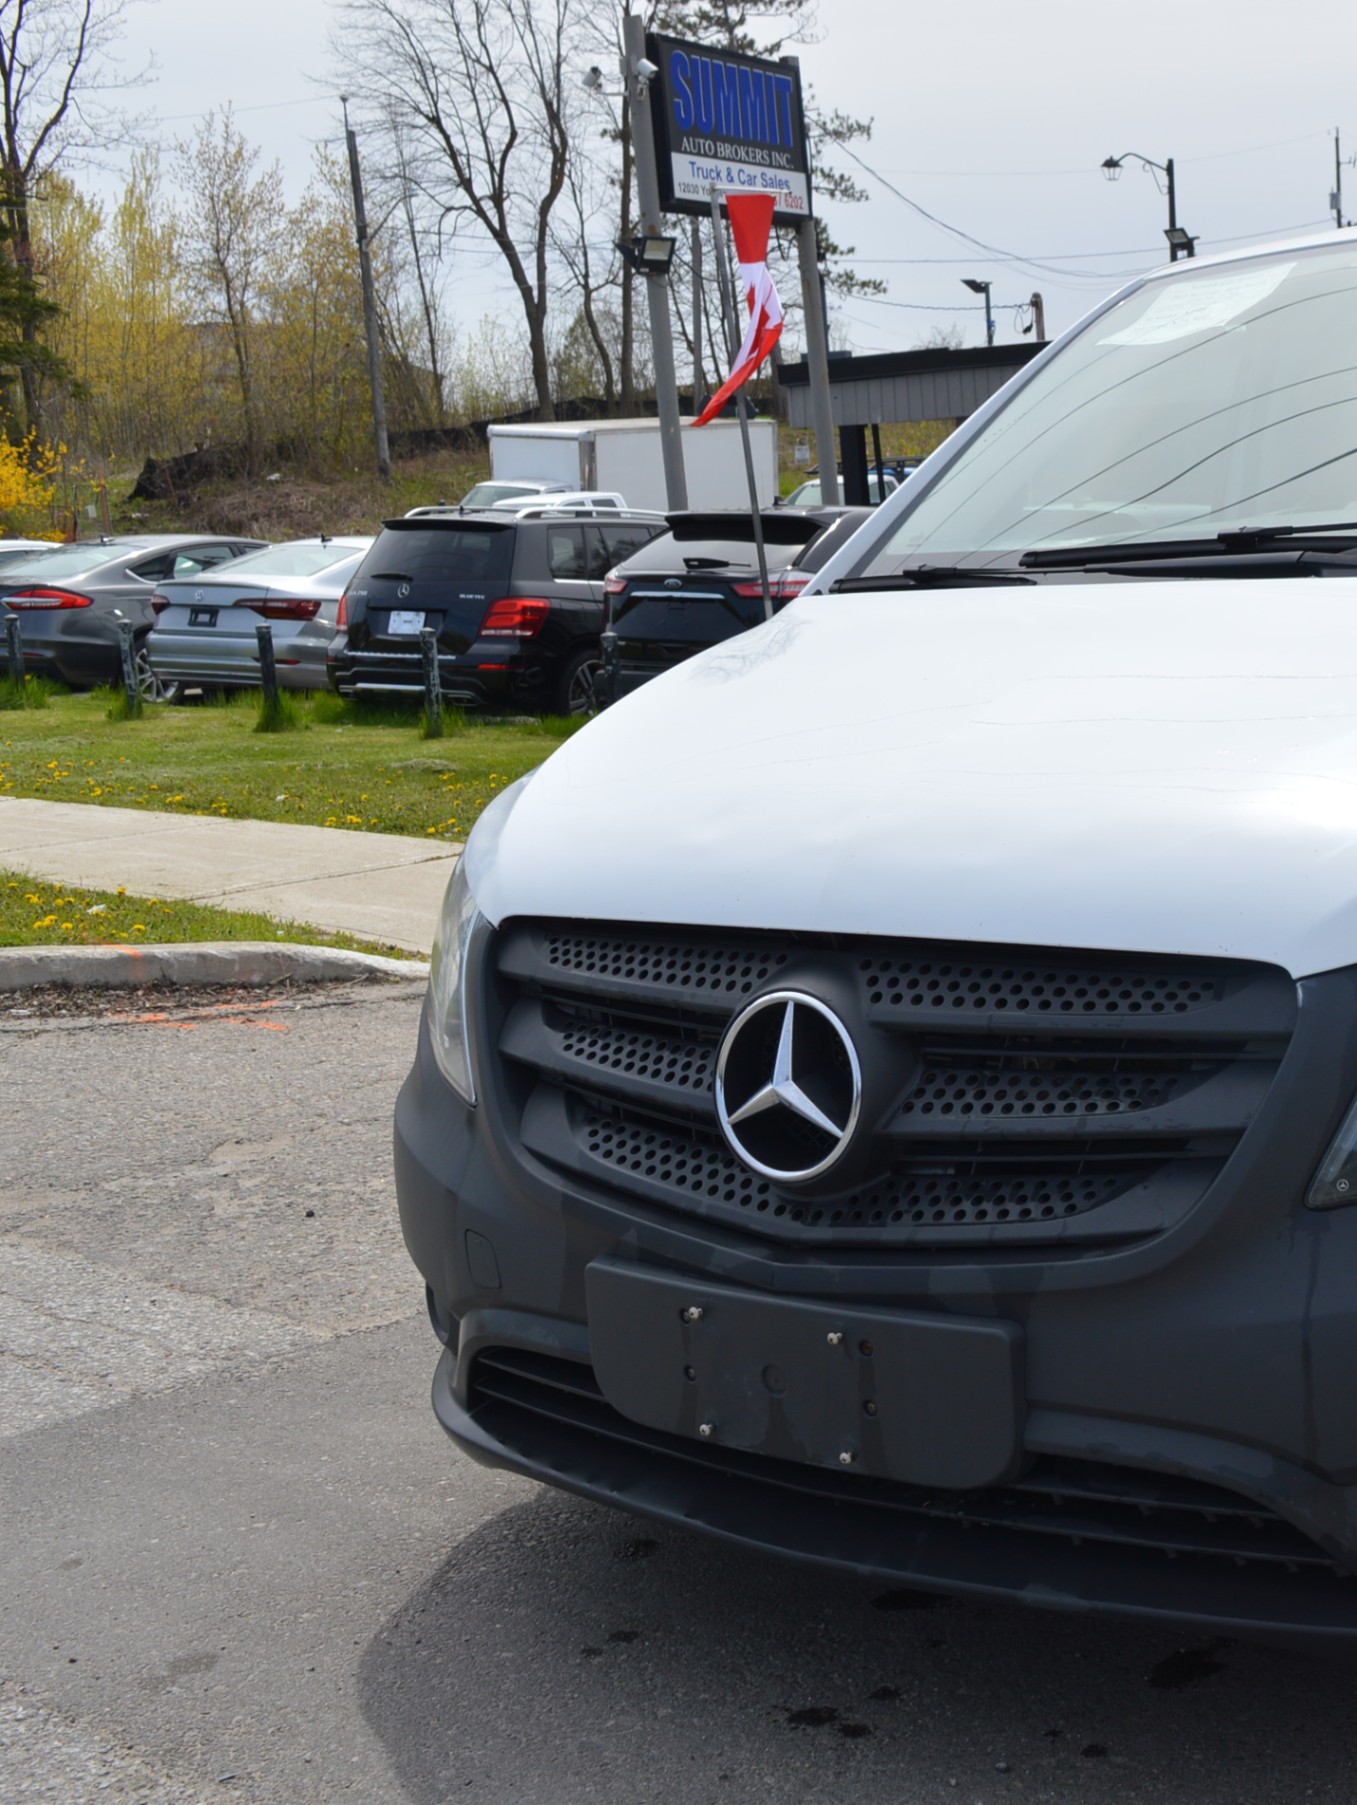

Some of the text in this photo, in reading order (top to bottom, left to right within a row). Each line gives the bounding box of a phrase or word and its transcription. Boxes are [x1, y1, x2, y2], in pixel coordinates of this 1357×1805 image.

[671, 50, 793, 148] SUMMIT
[682, 136, 794, 169] AUTO BROKERS INC.
[678, 182, 699, 195] 12030
[689, 161, 790, 190] Truck & Car Sales
